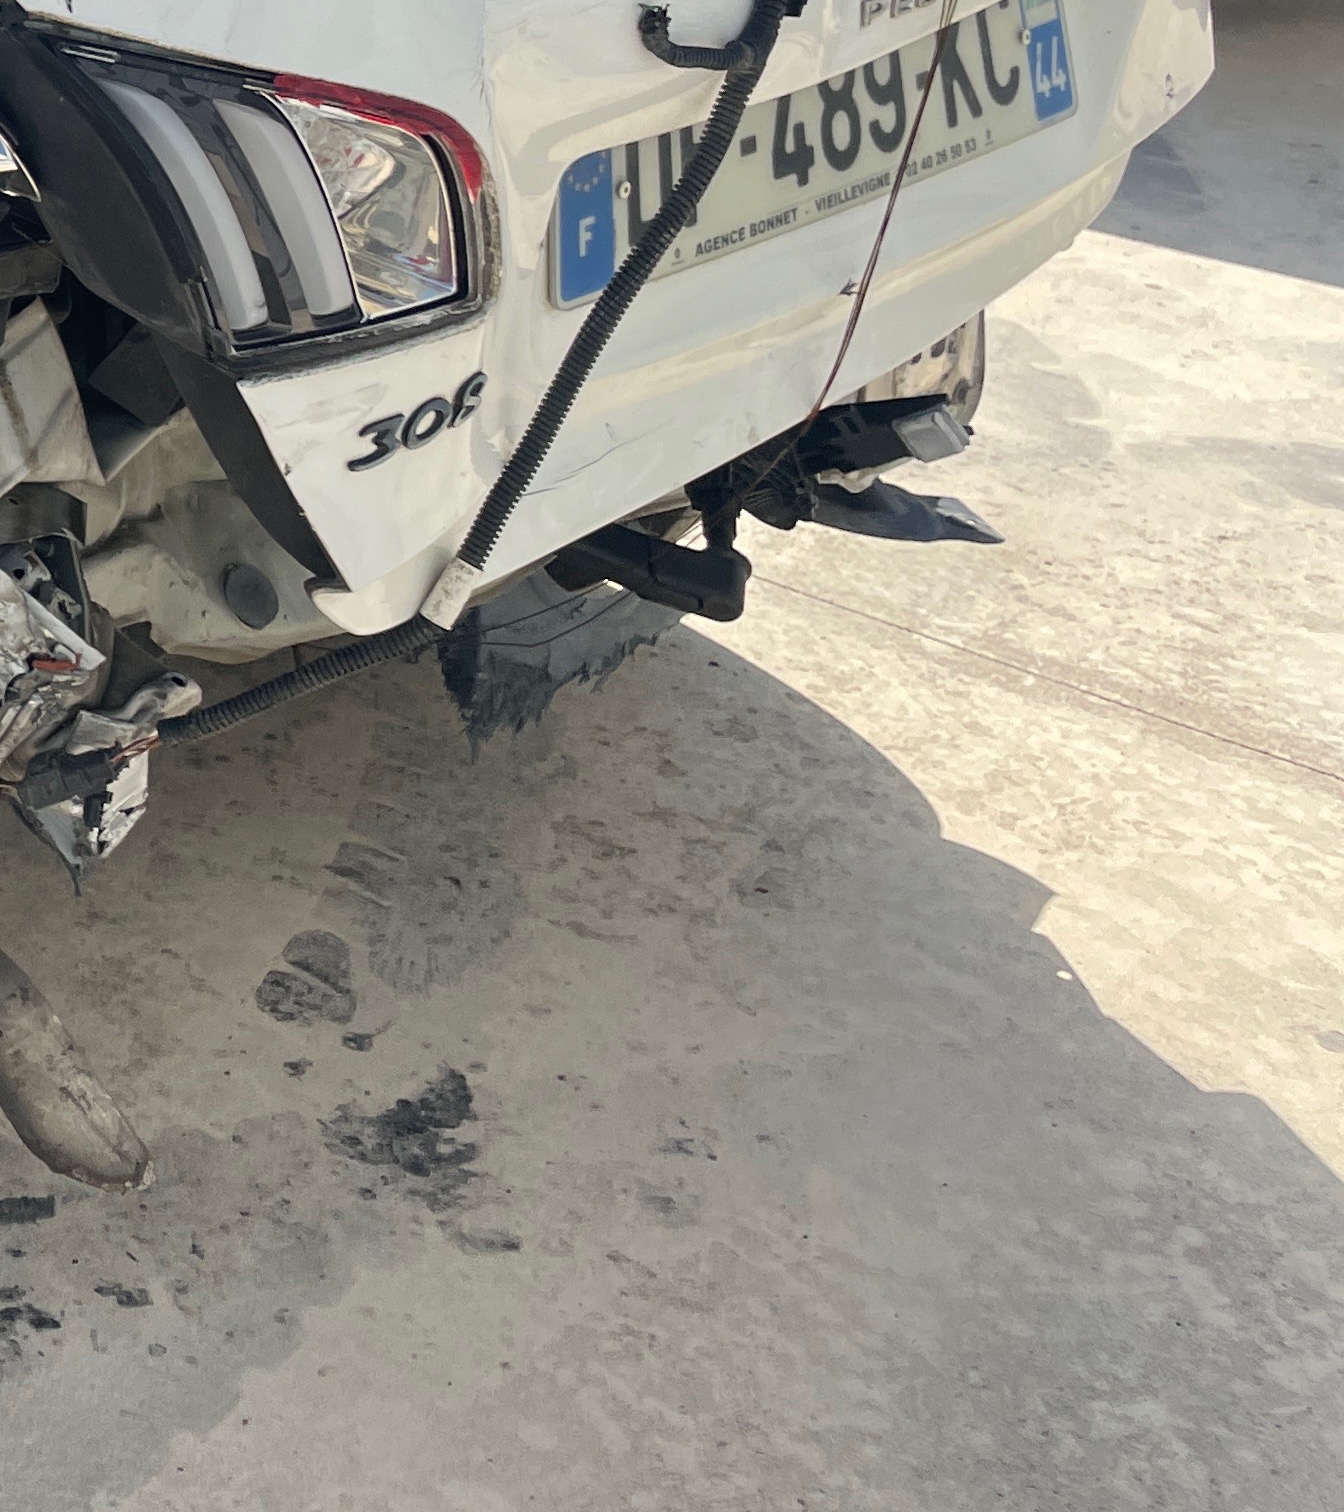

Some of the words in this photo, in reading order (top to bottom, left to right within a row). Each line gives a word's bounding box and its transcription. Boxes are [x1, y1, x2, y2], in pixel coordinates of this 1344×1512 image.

[1035, 35, 1067, 98] 44
[578, 215, 597, 258] F
[694, 226, 746, 258] AGENCE
[749, 206, 798, 238] BONNET
[814, 171, 891, 213] VIEILLEVIGNE
